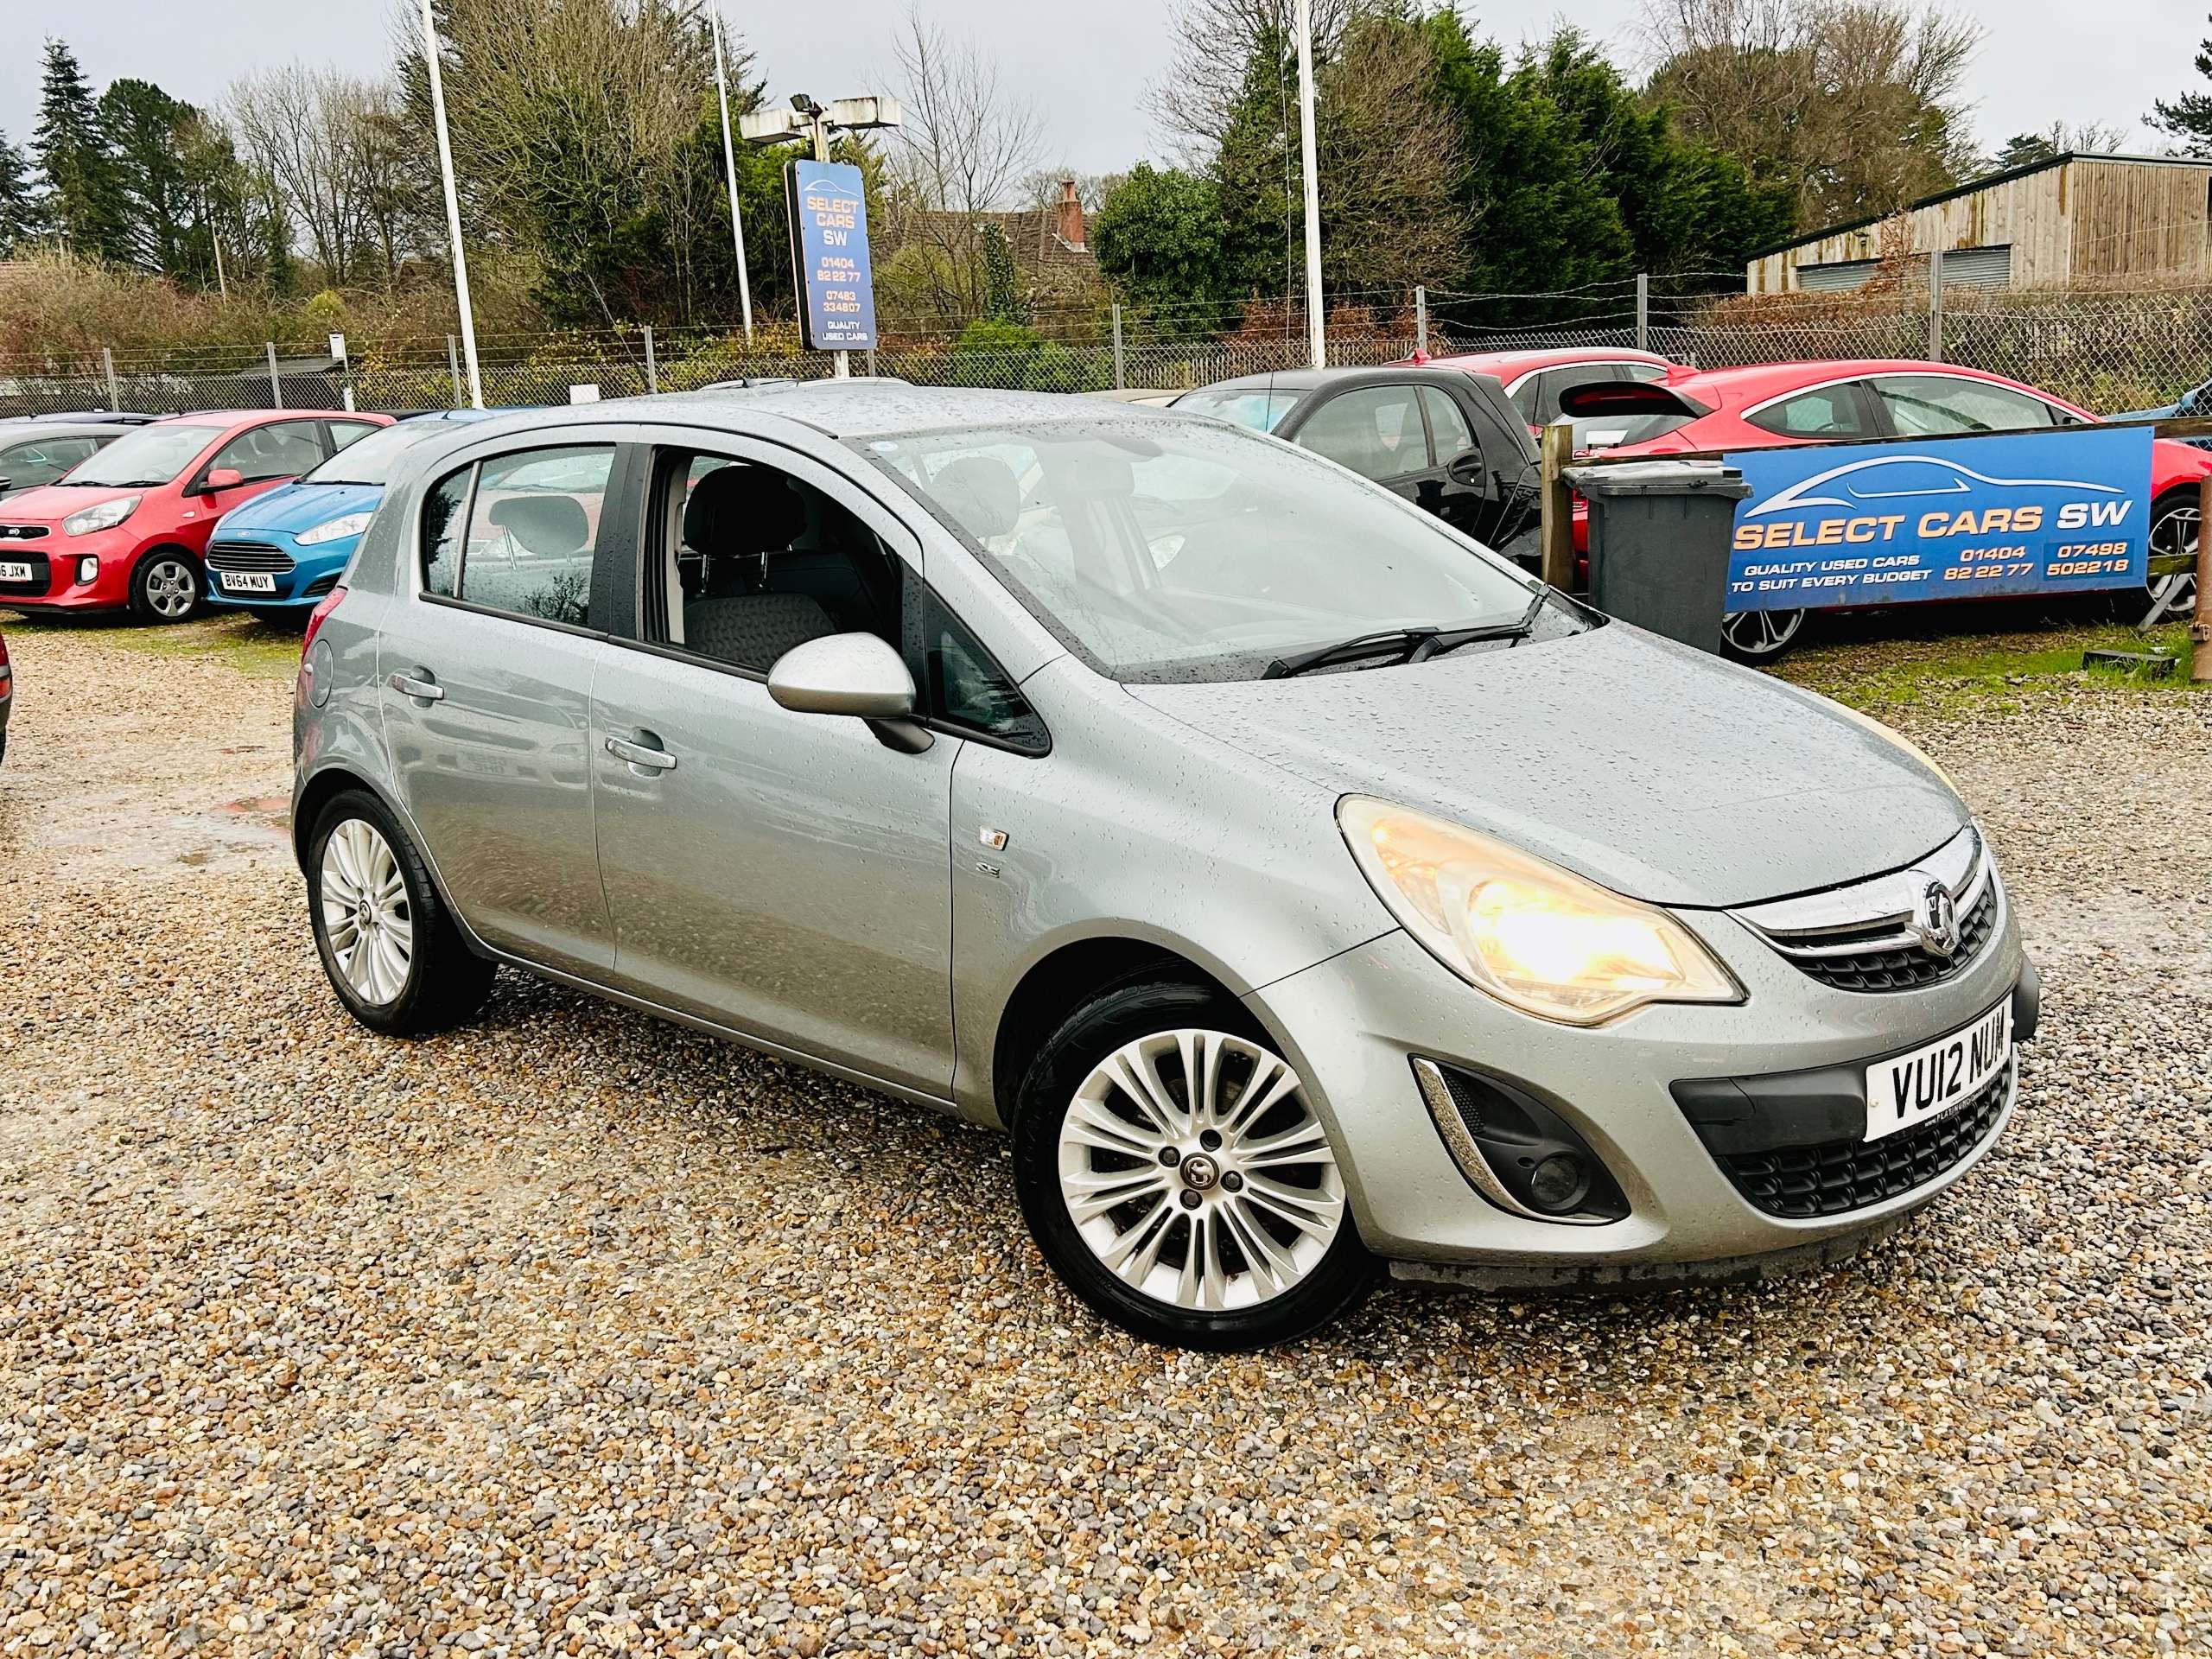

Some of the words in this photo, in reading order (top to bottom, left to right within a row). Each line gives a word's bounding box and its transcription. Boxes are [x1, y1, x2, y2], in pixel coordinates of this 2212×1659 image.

[807, 196, 859, 214] SELECT
[816, 213, 855, 229] CARS
[823, 230, 847, 246] SW
[821, 257, 855, 269] 01404
[827, 321, 861, 330] QUALITY
[822, 332, 844, 341] USED
[846, 332, 868, 341] CARS
[1733, 515, 1906, 551] SELECT
[1917, 505, 2044, 538] CARS
[2056, 499, 2134, 530] SW
[1960, 545, 2026, 563] 01404
[2057, 542, 2128, 558] 07498
[9, 565, 26, 577] JXM
[1744, 561, 1818, 577] QUALITY
[1821, 557, 1868, 572] USED
[1872, 554, 1921, 568] CARS
[2046, 559, 2130, 576] 502218
[225, 574, 249, 588] BV64
[249, 575, 269, 588] MUY
[1731, 581, 1754, 593] TO
[1758, 577, 1798, 592] SUIT
[1801, 574, 1859, 588] EVERY
[1862, 569, 1933, 585] BUDGET
[1892, 1041, 1963, 1119] VU12
[1969, 1006, 2005, 1084] NUM
